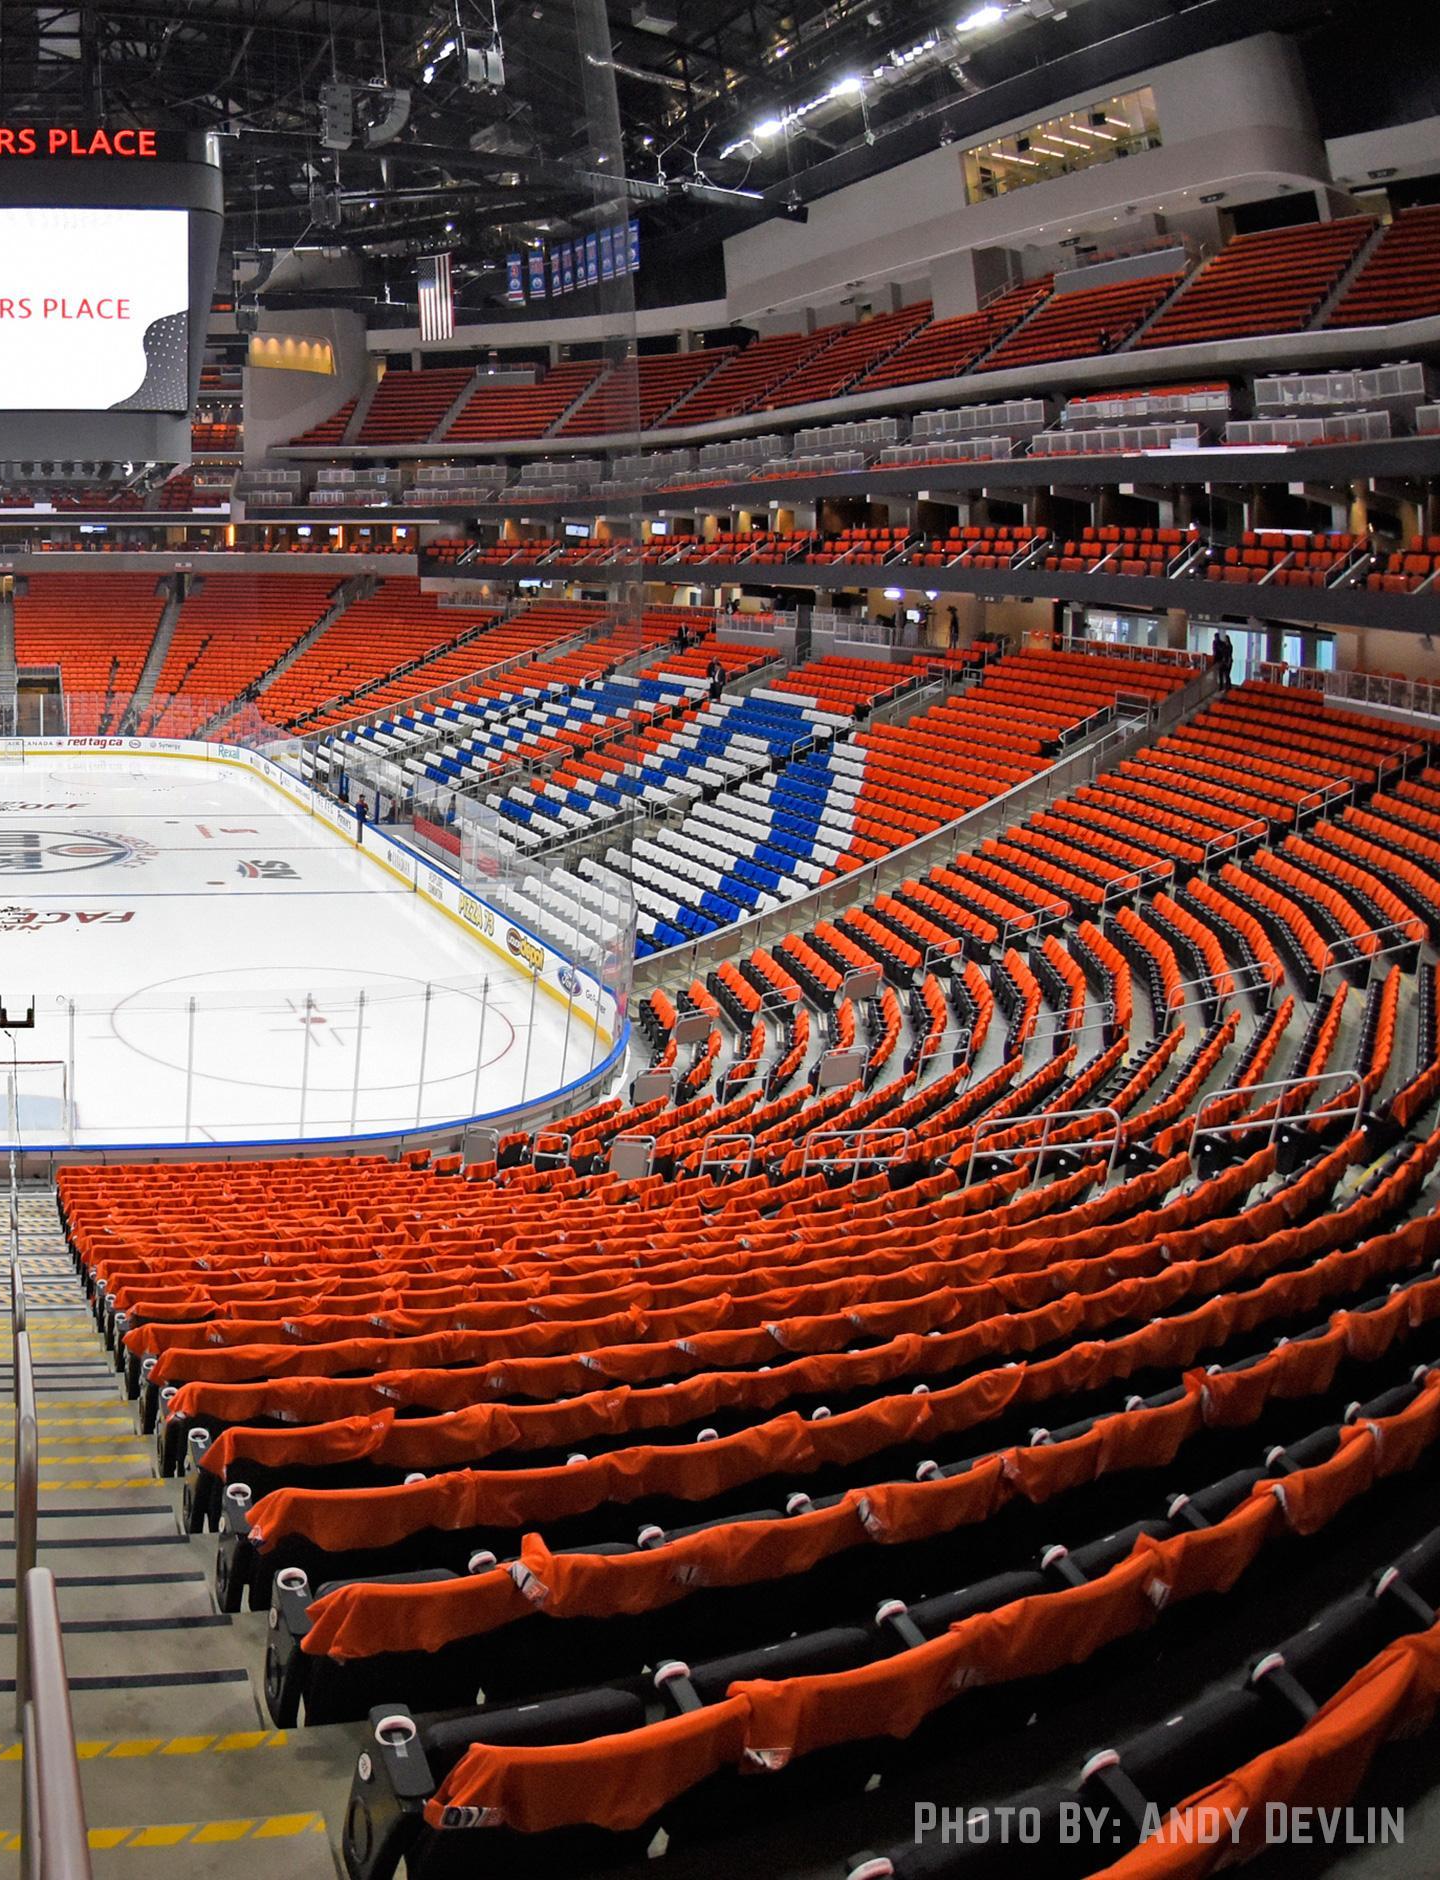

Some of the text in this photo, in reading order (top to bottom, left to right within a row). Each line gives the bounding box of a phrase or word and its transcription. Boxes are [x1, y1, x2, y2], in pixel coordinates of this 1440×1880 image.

[48, 129, 157, 156] PLACE
[44, 298, 129, 319] PLACE
[218, 744, 240, 760] Rexall
[458, 893, 495, 937] PIZZA 73
